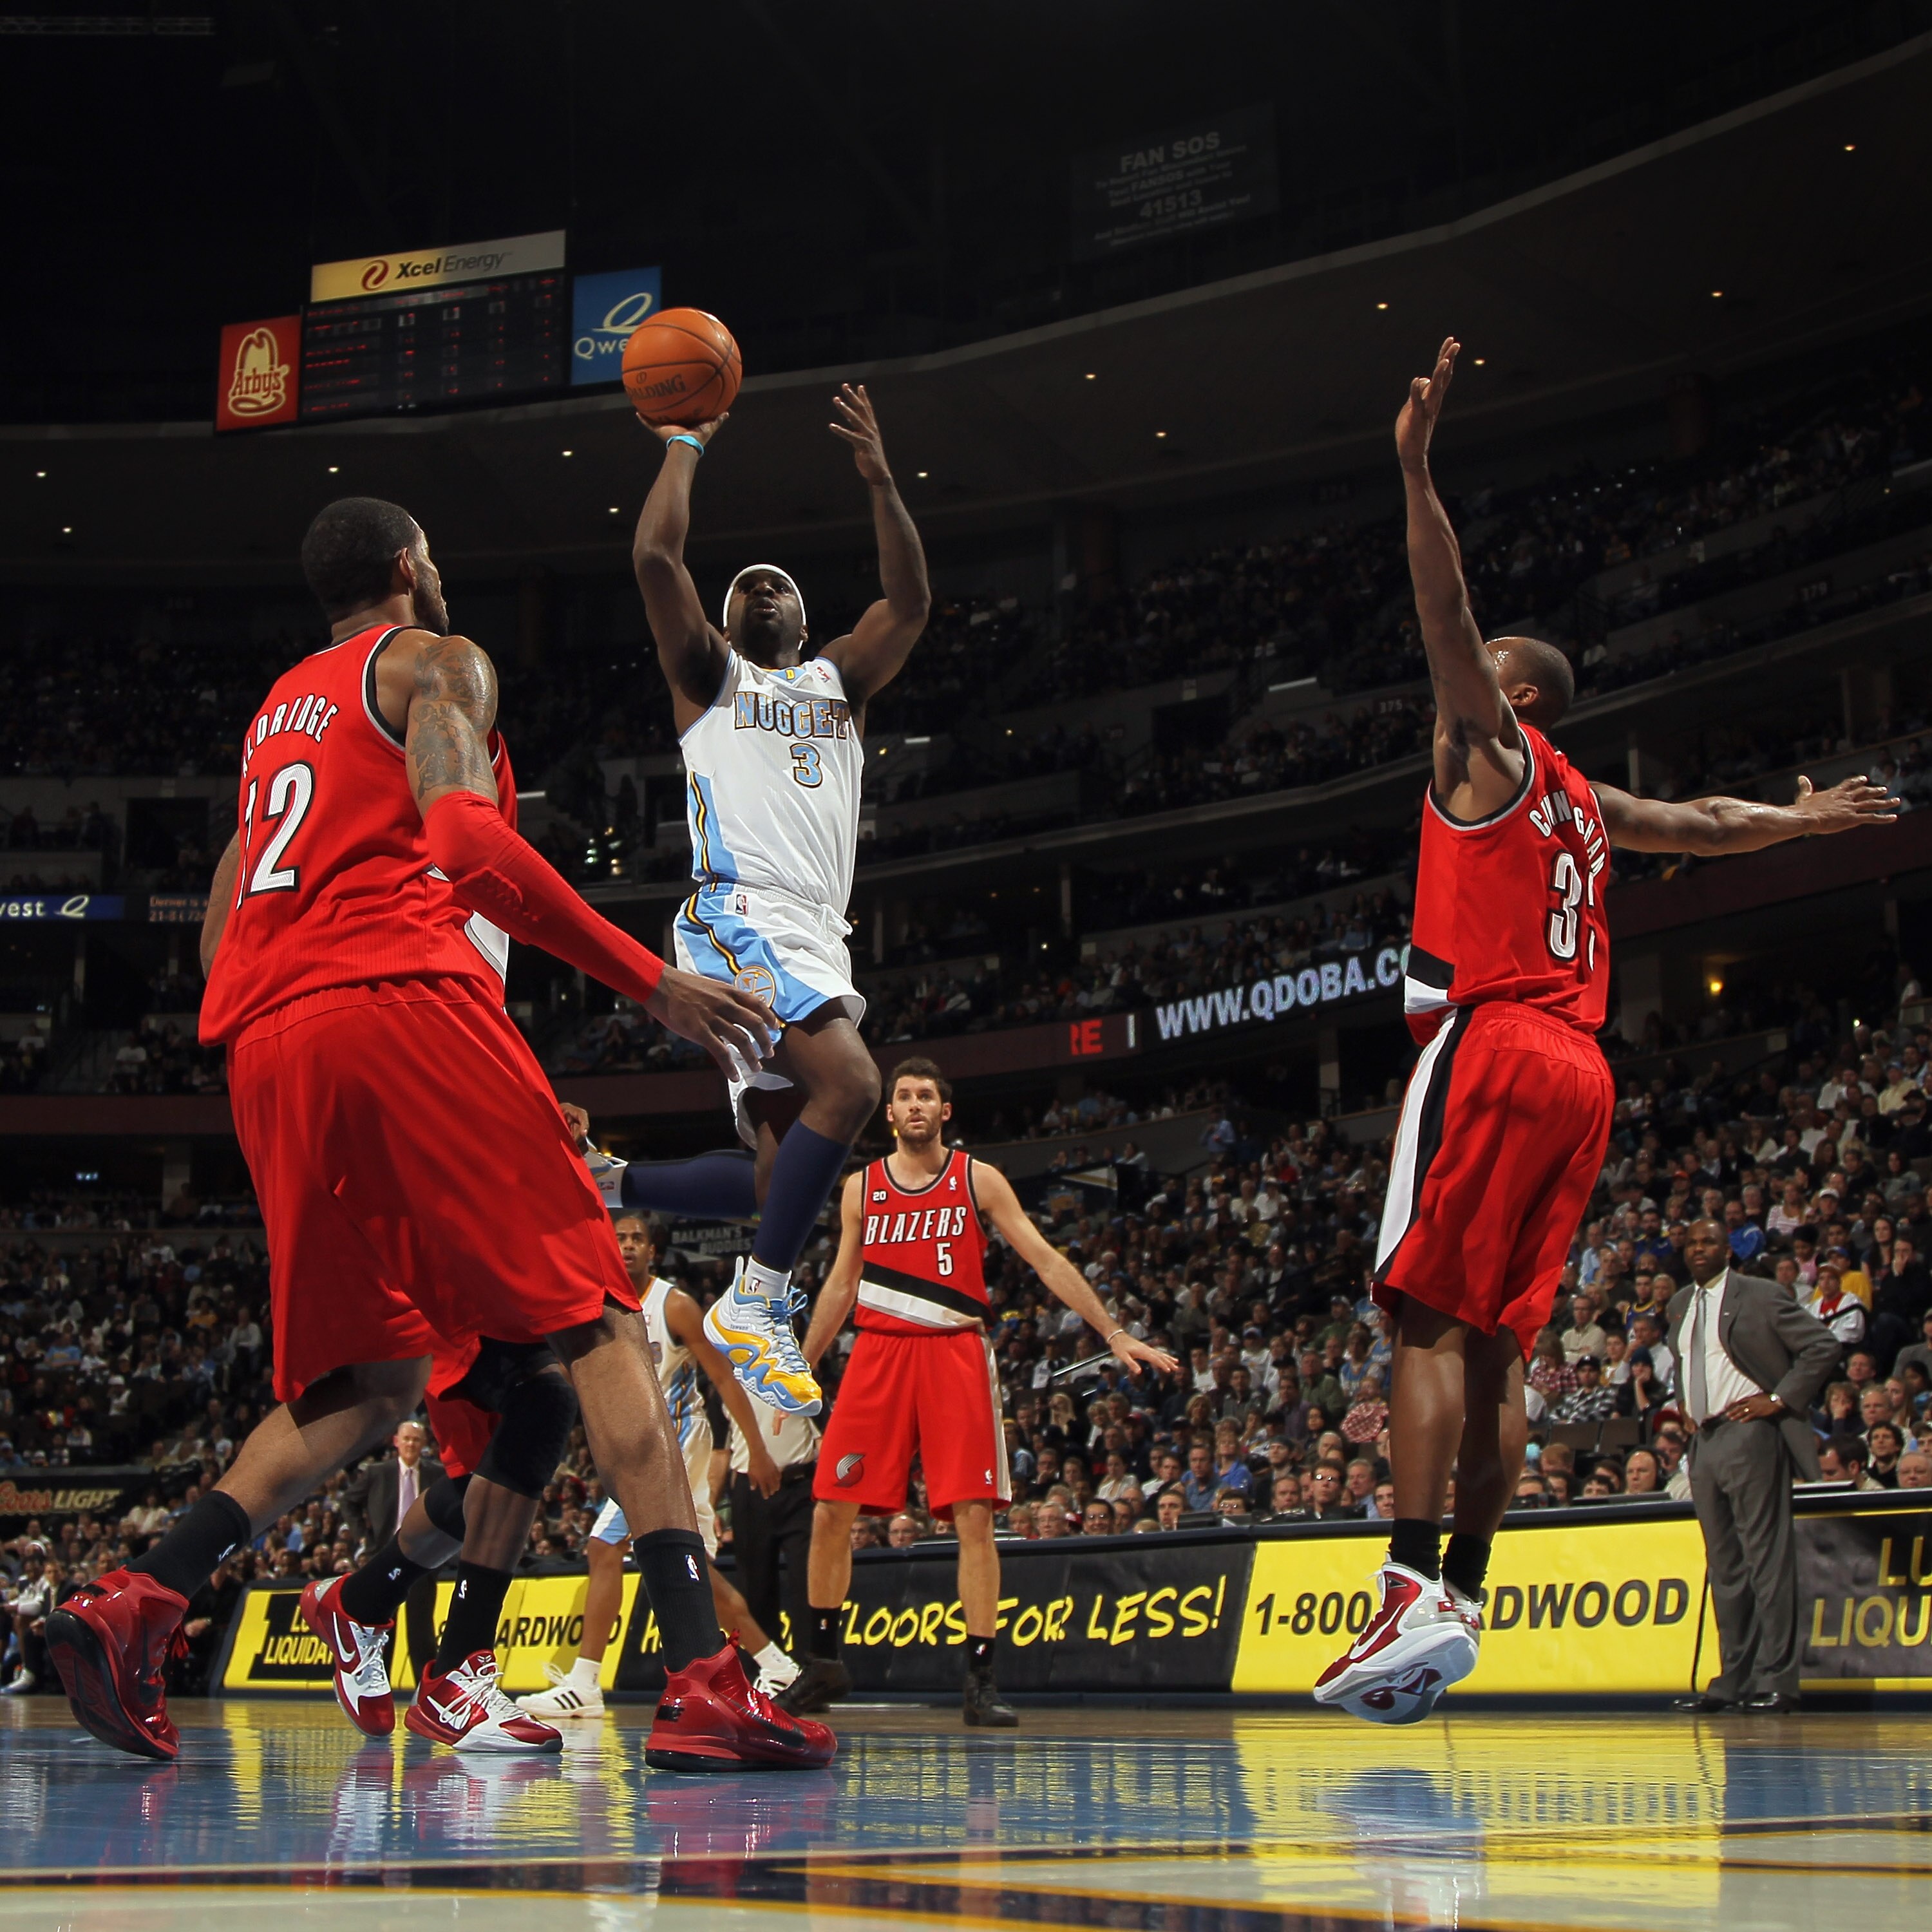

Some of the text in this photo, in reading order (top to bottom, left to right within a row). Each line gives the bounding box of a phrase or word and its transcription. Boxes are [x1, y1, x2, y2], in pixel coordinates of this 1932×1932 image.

[1121, 146, 1164, 173] FAN
[1172, 131, 1220, 159] SOS
[1139, 189, 1202, 218] 41513
[395, 254, 505, 279] Xcel Energy
[627, 374, 686, 399] PALDING
[790, 743, 823, 788] 3
[236, 760, 316, 911] 12
[873, 1190, 887, 1202] 20
[864, 1206, 967, 1245] BLAZERS
[936, 1242, 953, 1276] 5
[54, 1488, 123, 1511] LIGHT
[1088, 1574, 1226, 1647] LESS!
[1256, 1590, 1373, 1637] 1-800
[495, 1614, 622, 1649] ARDWOD
[263, 1635, 334, 1665] LIQUIDA
